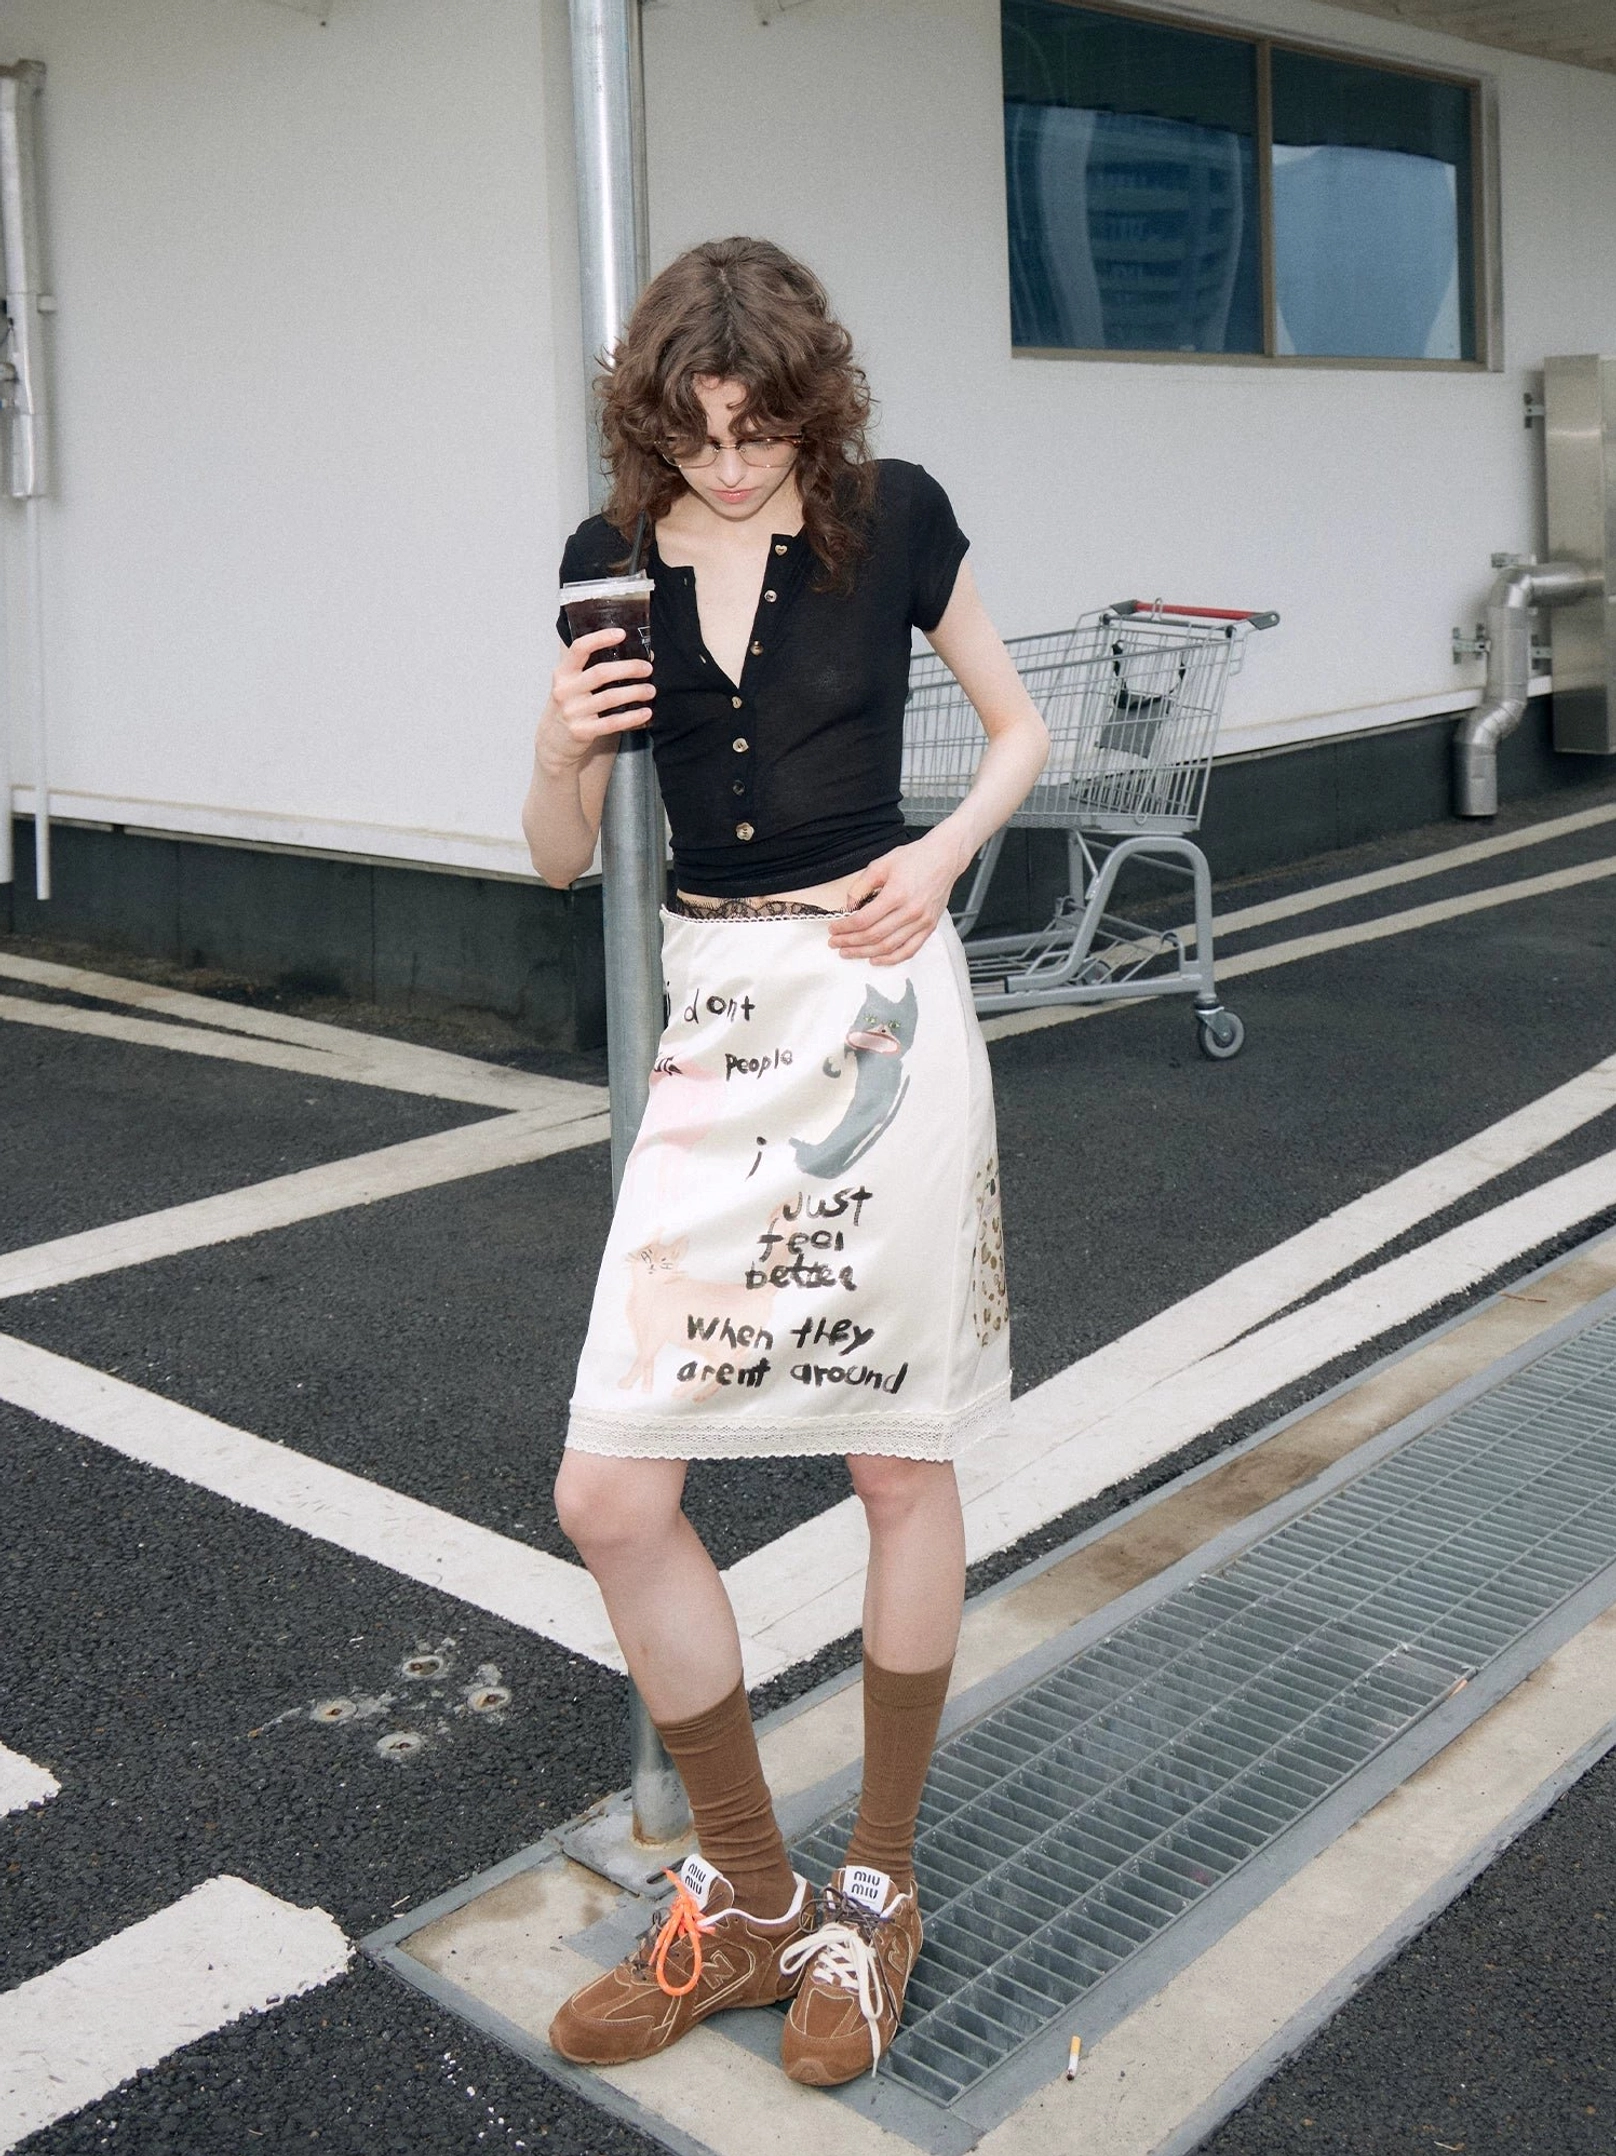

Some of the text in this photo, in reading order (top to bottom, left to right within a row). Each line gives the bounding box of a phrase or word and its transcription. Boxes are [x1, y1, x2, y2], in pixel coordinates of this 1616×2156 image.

[757, 1217, 844, 1262] feel
[790, 1316, 874, 1356] they
[676, 1357, 908, 1394] arent around
